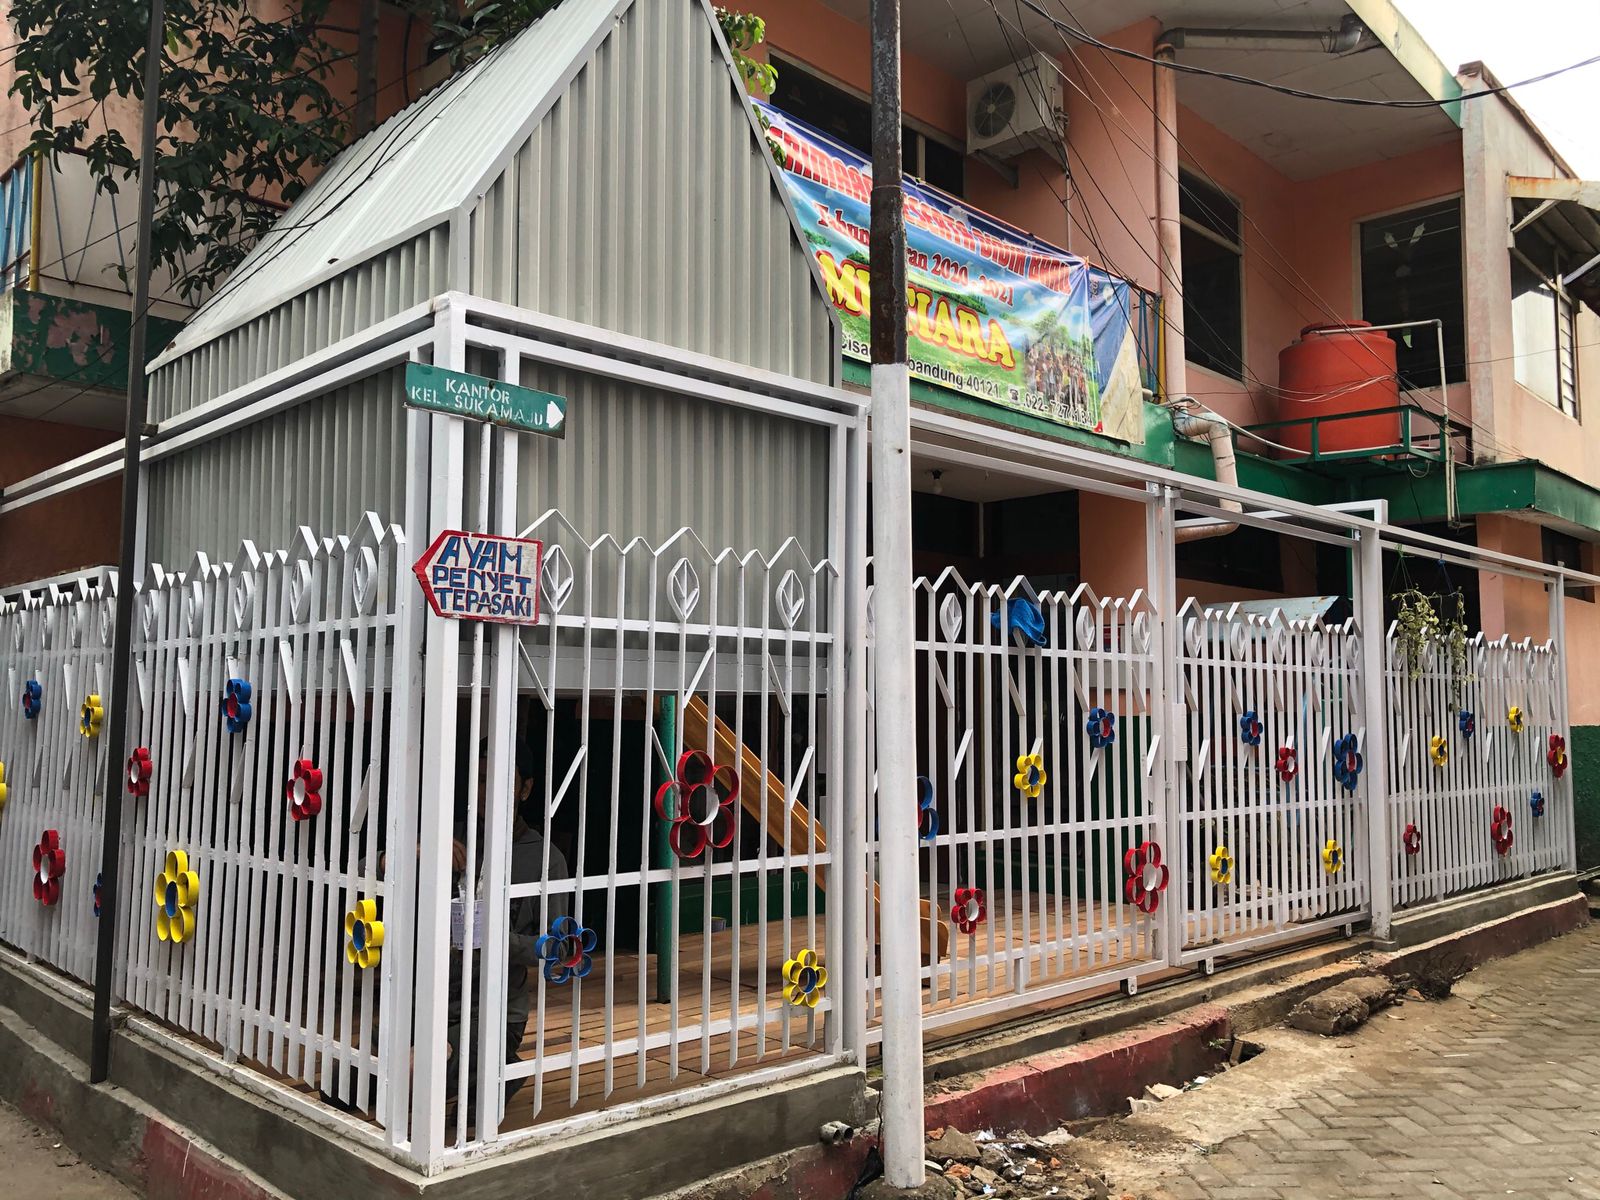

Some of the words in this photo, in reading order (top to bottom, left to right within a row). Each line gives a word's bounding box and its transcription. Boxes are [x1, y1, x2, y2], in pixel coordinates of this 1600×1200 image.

[931, 252, 969, 286] 2020
[979, 274, 1014, 307] 2021
[445, 378, 510, 405] KANTOR
[454, 394, 544, 426] SUKAMAJU
[437, 536, 523, 575] AYAM
[432, 565, 532, 595] PENYET
[434, 588, 532, 617] TEPASAKI
